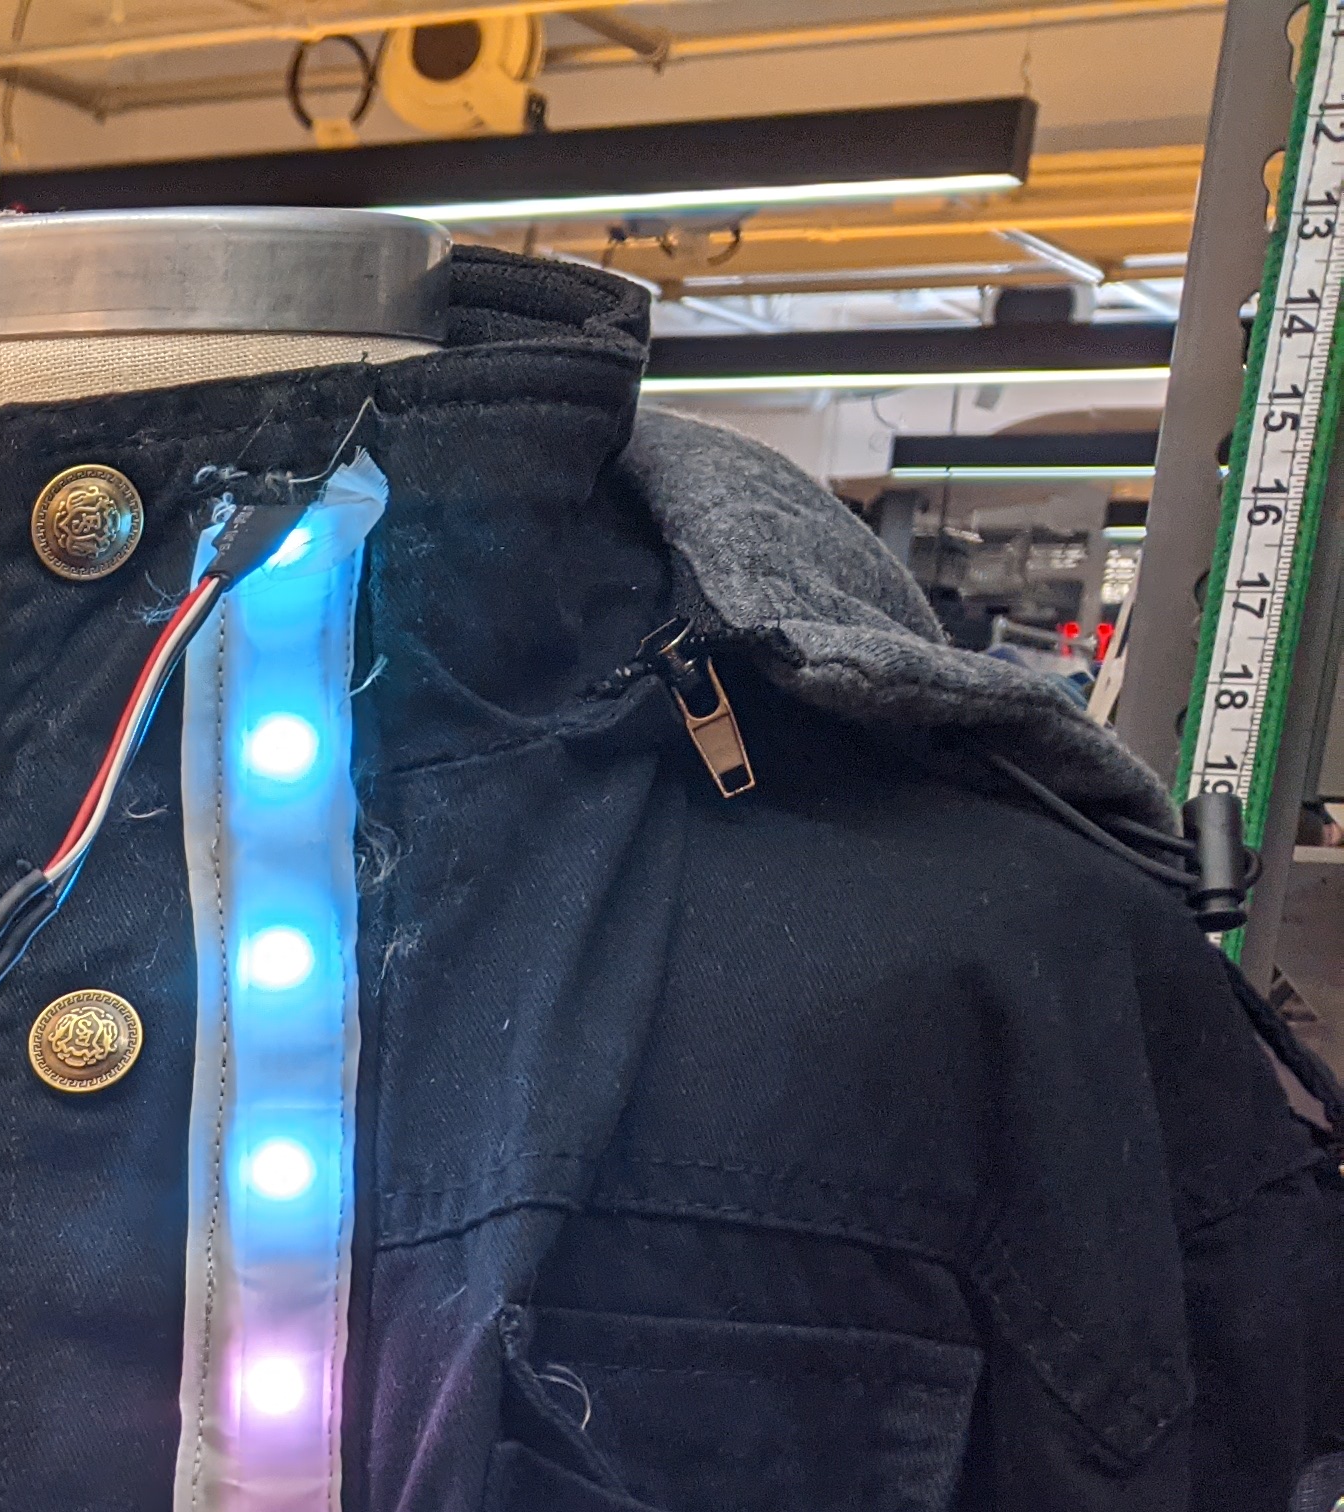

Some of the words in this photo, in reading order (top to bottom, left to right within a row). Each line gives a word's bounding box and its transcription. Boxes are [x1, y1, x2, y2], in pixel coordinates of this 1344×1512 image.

[1297, 191, 1340, 240] 13
[1280, 289, 1321, 338] 14
[1263, 384, 1304, 432] 15
[1247, 478, 1288, 526] 16
[1232, 572, 1270, 619] 17
[1215, 664, 1253, 709] 18
[1201, 754, 1238, 795] 19
